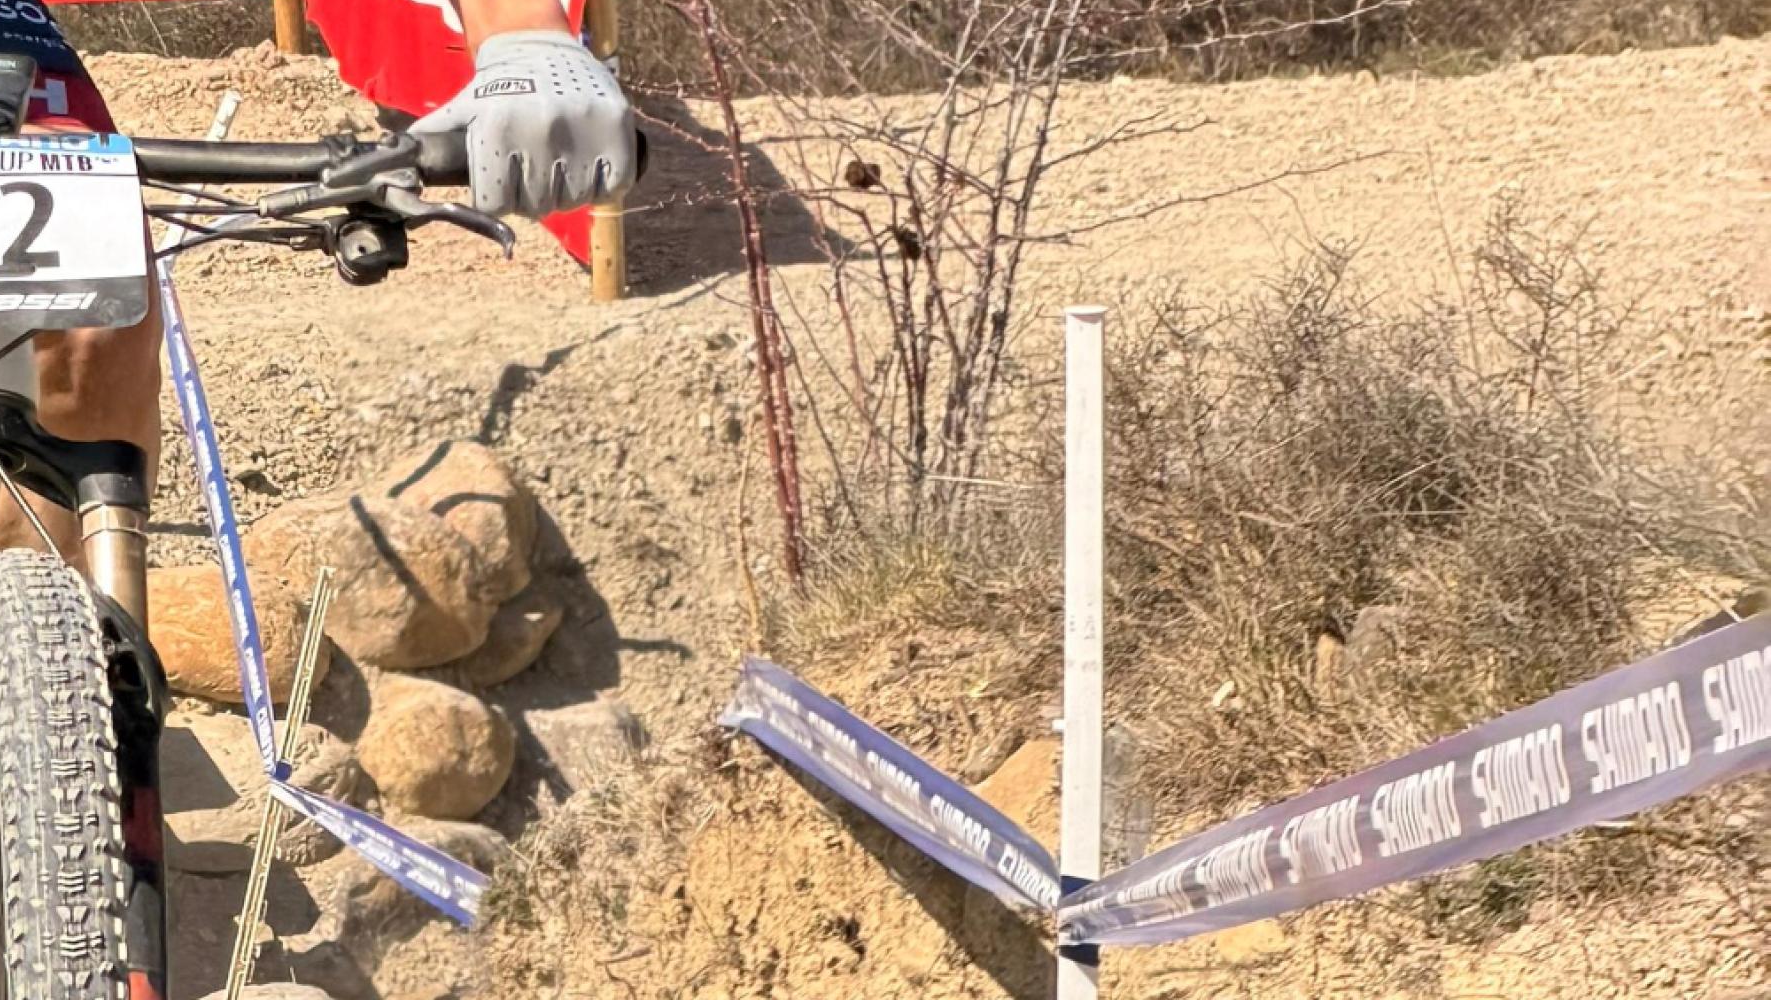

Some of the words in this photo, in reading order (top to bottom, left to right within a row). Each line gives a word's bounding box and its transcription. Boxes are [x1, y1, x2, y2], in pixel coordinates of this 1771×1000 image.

[39, 152, 94, 172] MTB
[1371, 760, 1462, 857] SHIMANO
[1471, 722, 1571, 828] SHIMANO
[1581, 680, 1692, 794] SHIMANO
